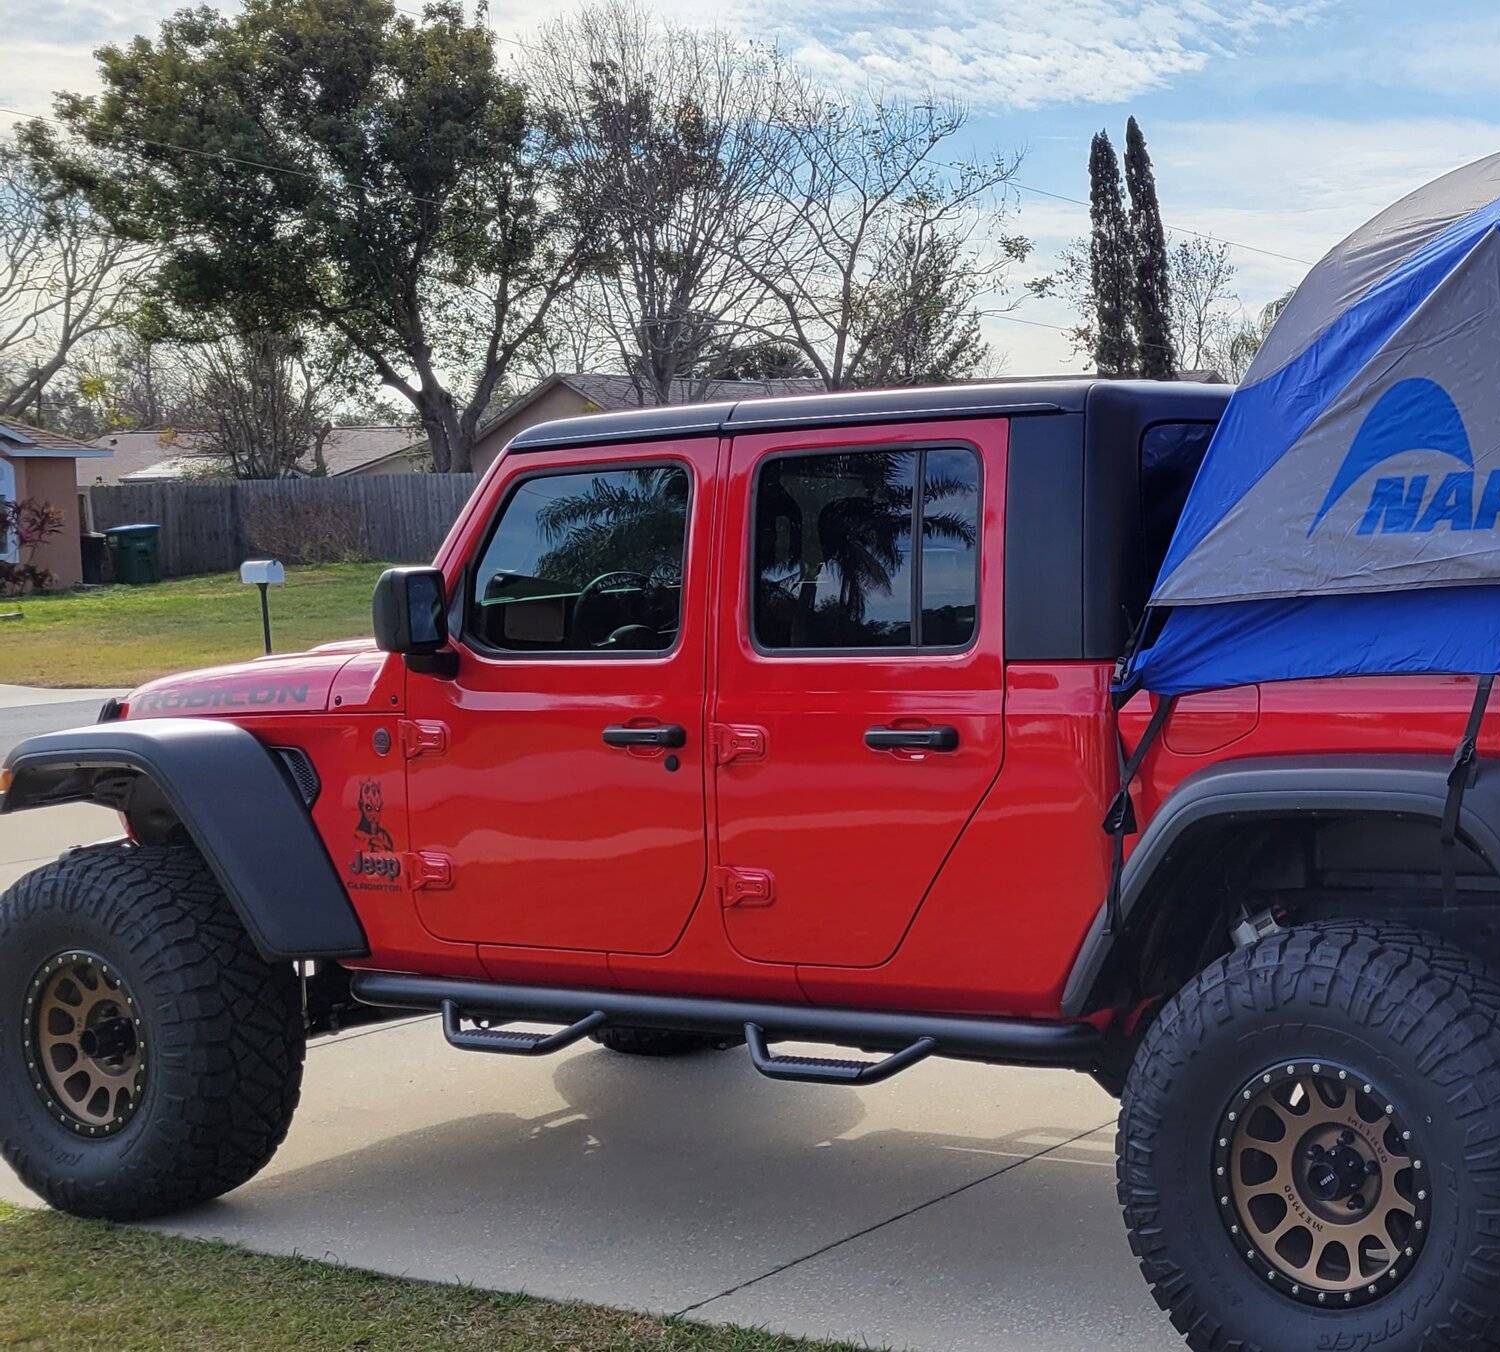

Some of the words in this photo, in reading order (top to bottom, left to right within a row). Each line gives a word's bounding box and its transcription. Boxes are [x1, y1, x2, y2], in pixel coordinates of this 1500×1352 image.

[135, 685, 309, 711] RUBICON
[349, 850, 401, 880] Jeep
[347, 881, 403, 893] GLADIATOR
[1284, 1185, 1324, 1232] METHOD
